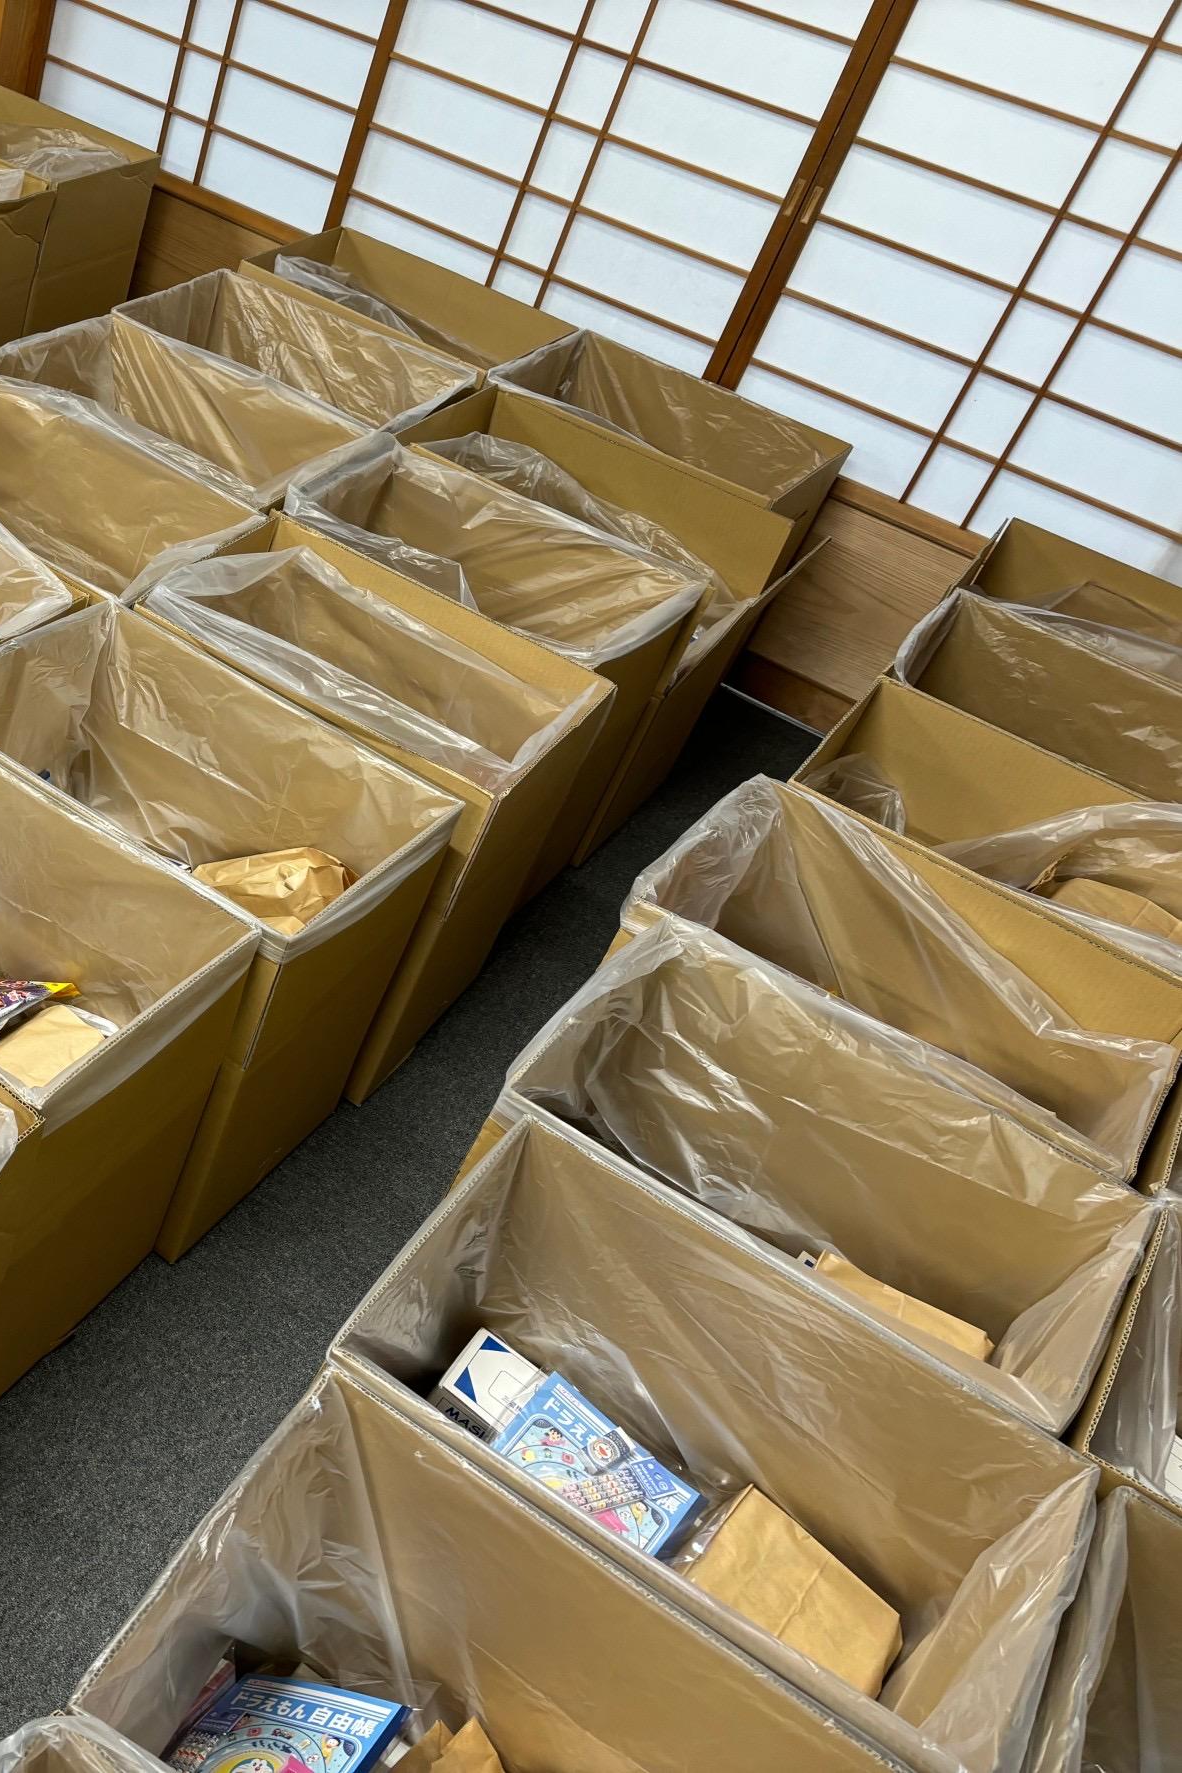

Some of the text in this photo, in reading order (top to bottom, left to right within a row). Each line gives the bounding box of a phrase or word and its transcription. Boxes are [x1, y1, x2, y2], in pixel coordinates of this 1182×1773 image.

[230, 1691, 381, 1739] ドラえもん 自由帳
